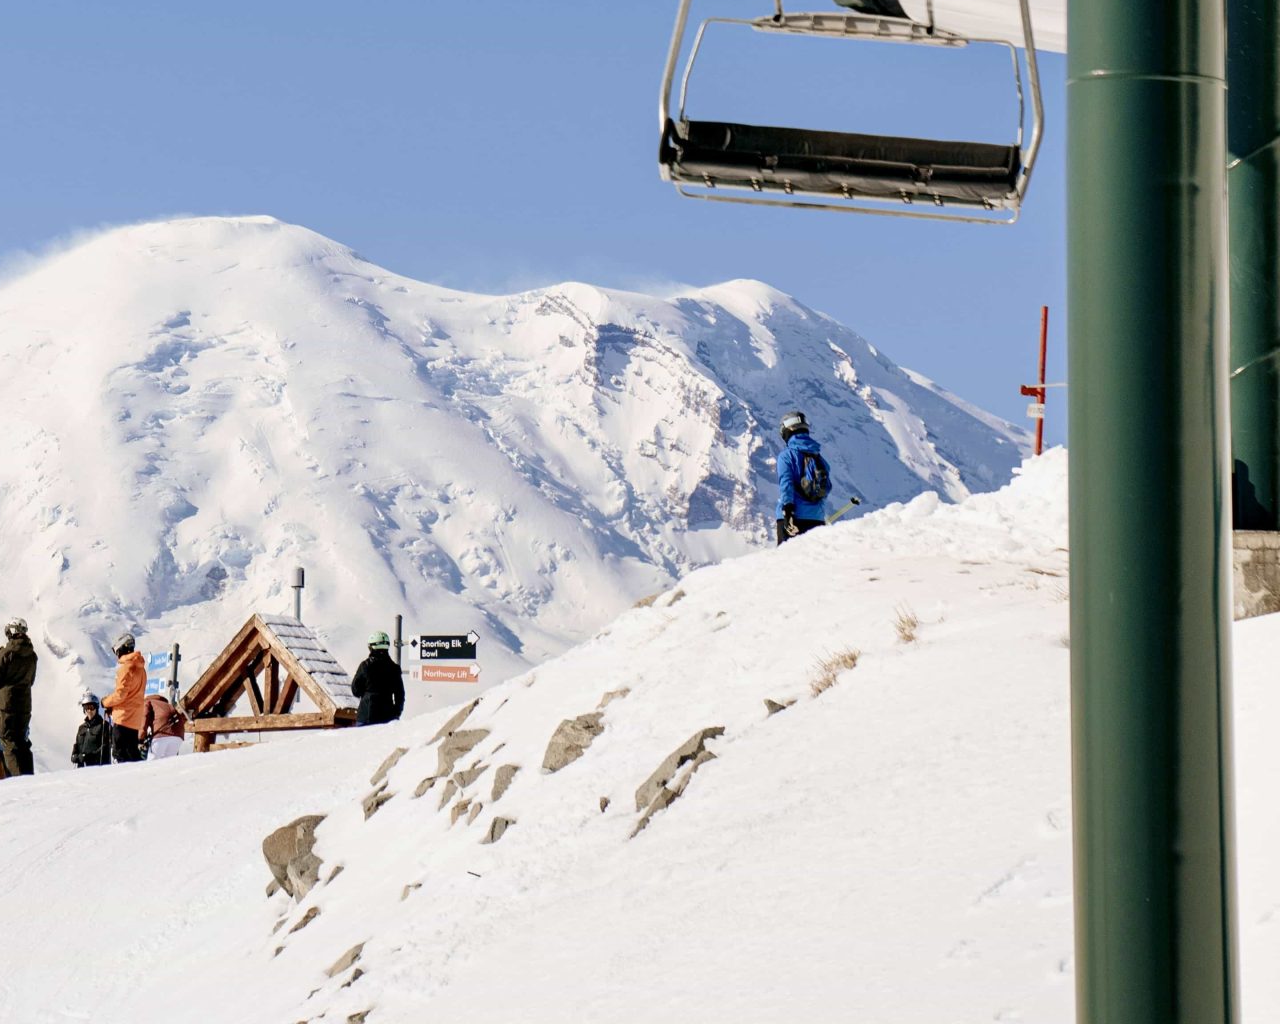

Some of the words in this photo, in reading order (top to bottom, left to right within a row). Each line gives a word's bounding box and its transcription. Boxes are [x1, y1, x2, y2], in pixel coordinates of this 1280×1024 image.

[422, 640, 450, 649] Snorting
[451, 639, 462, 648] Elk
[422, 649, 438, 658] Bowl
[423, 670, 456, 679] Northway
